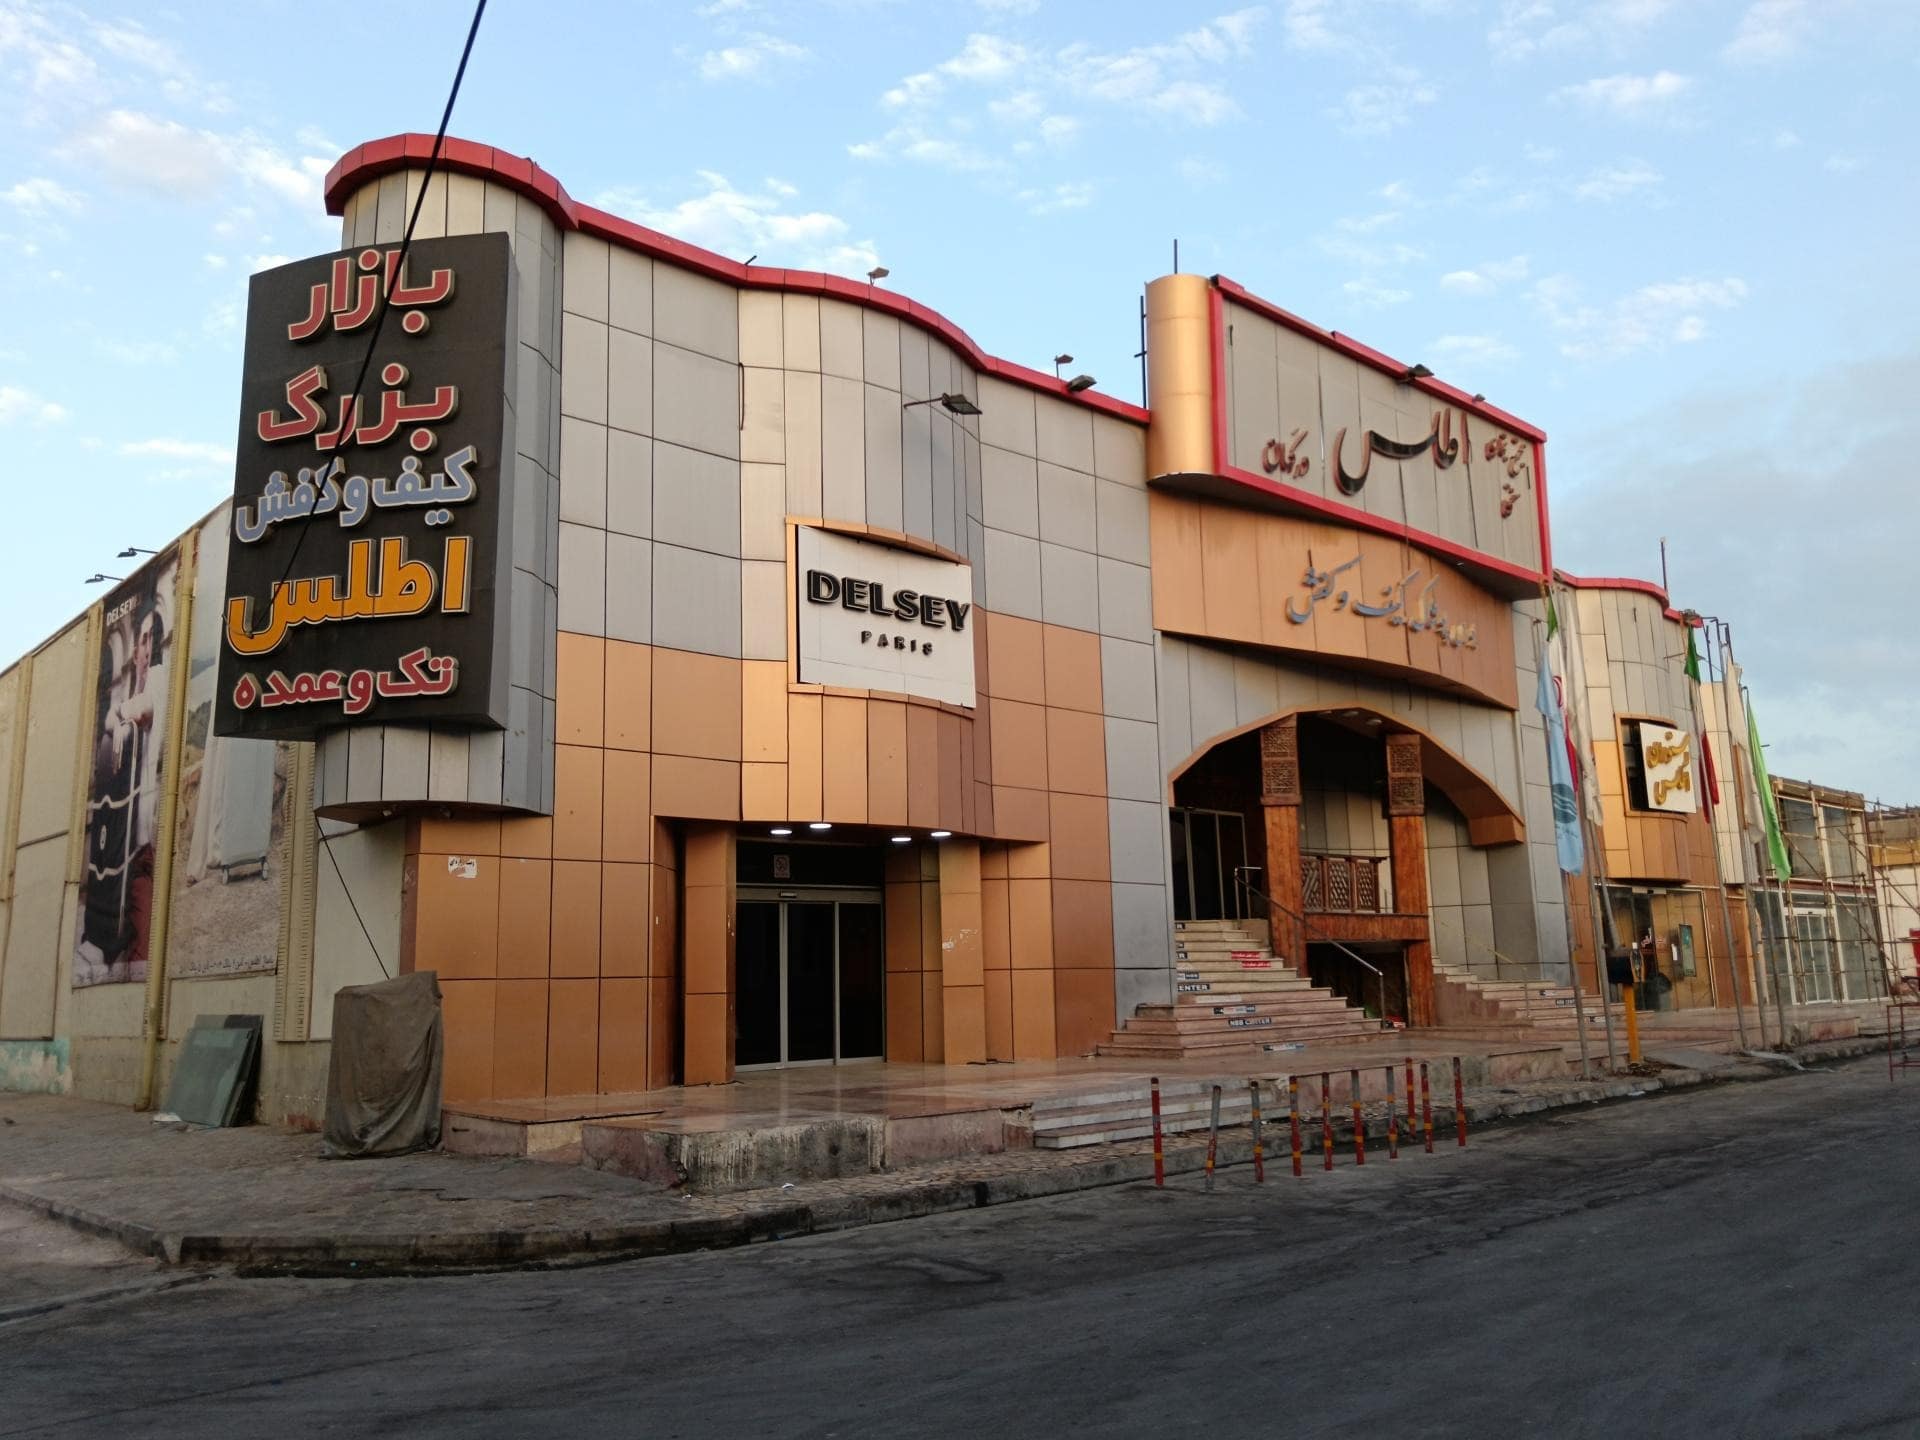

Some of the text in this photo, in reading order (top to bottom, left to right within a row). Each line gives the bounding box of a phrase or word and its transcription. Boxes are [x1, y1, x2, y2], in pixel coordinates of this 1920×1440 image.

[288, 249, 456, 341] بازار
[258, 363, 459, 452] بزرگ
[1333, 407, 1470, 496] اطلس
[235, 445, 478, 543] کیف و کفش
[226, 536, 474, 656] اطلس
[806, 569, 971, 633] DELSEY
[233, 646, 459, 715] تک و عمده
[860, 629, 934, 657] PARIS
